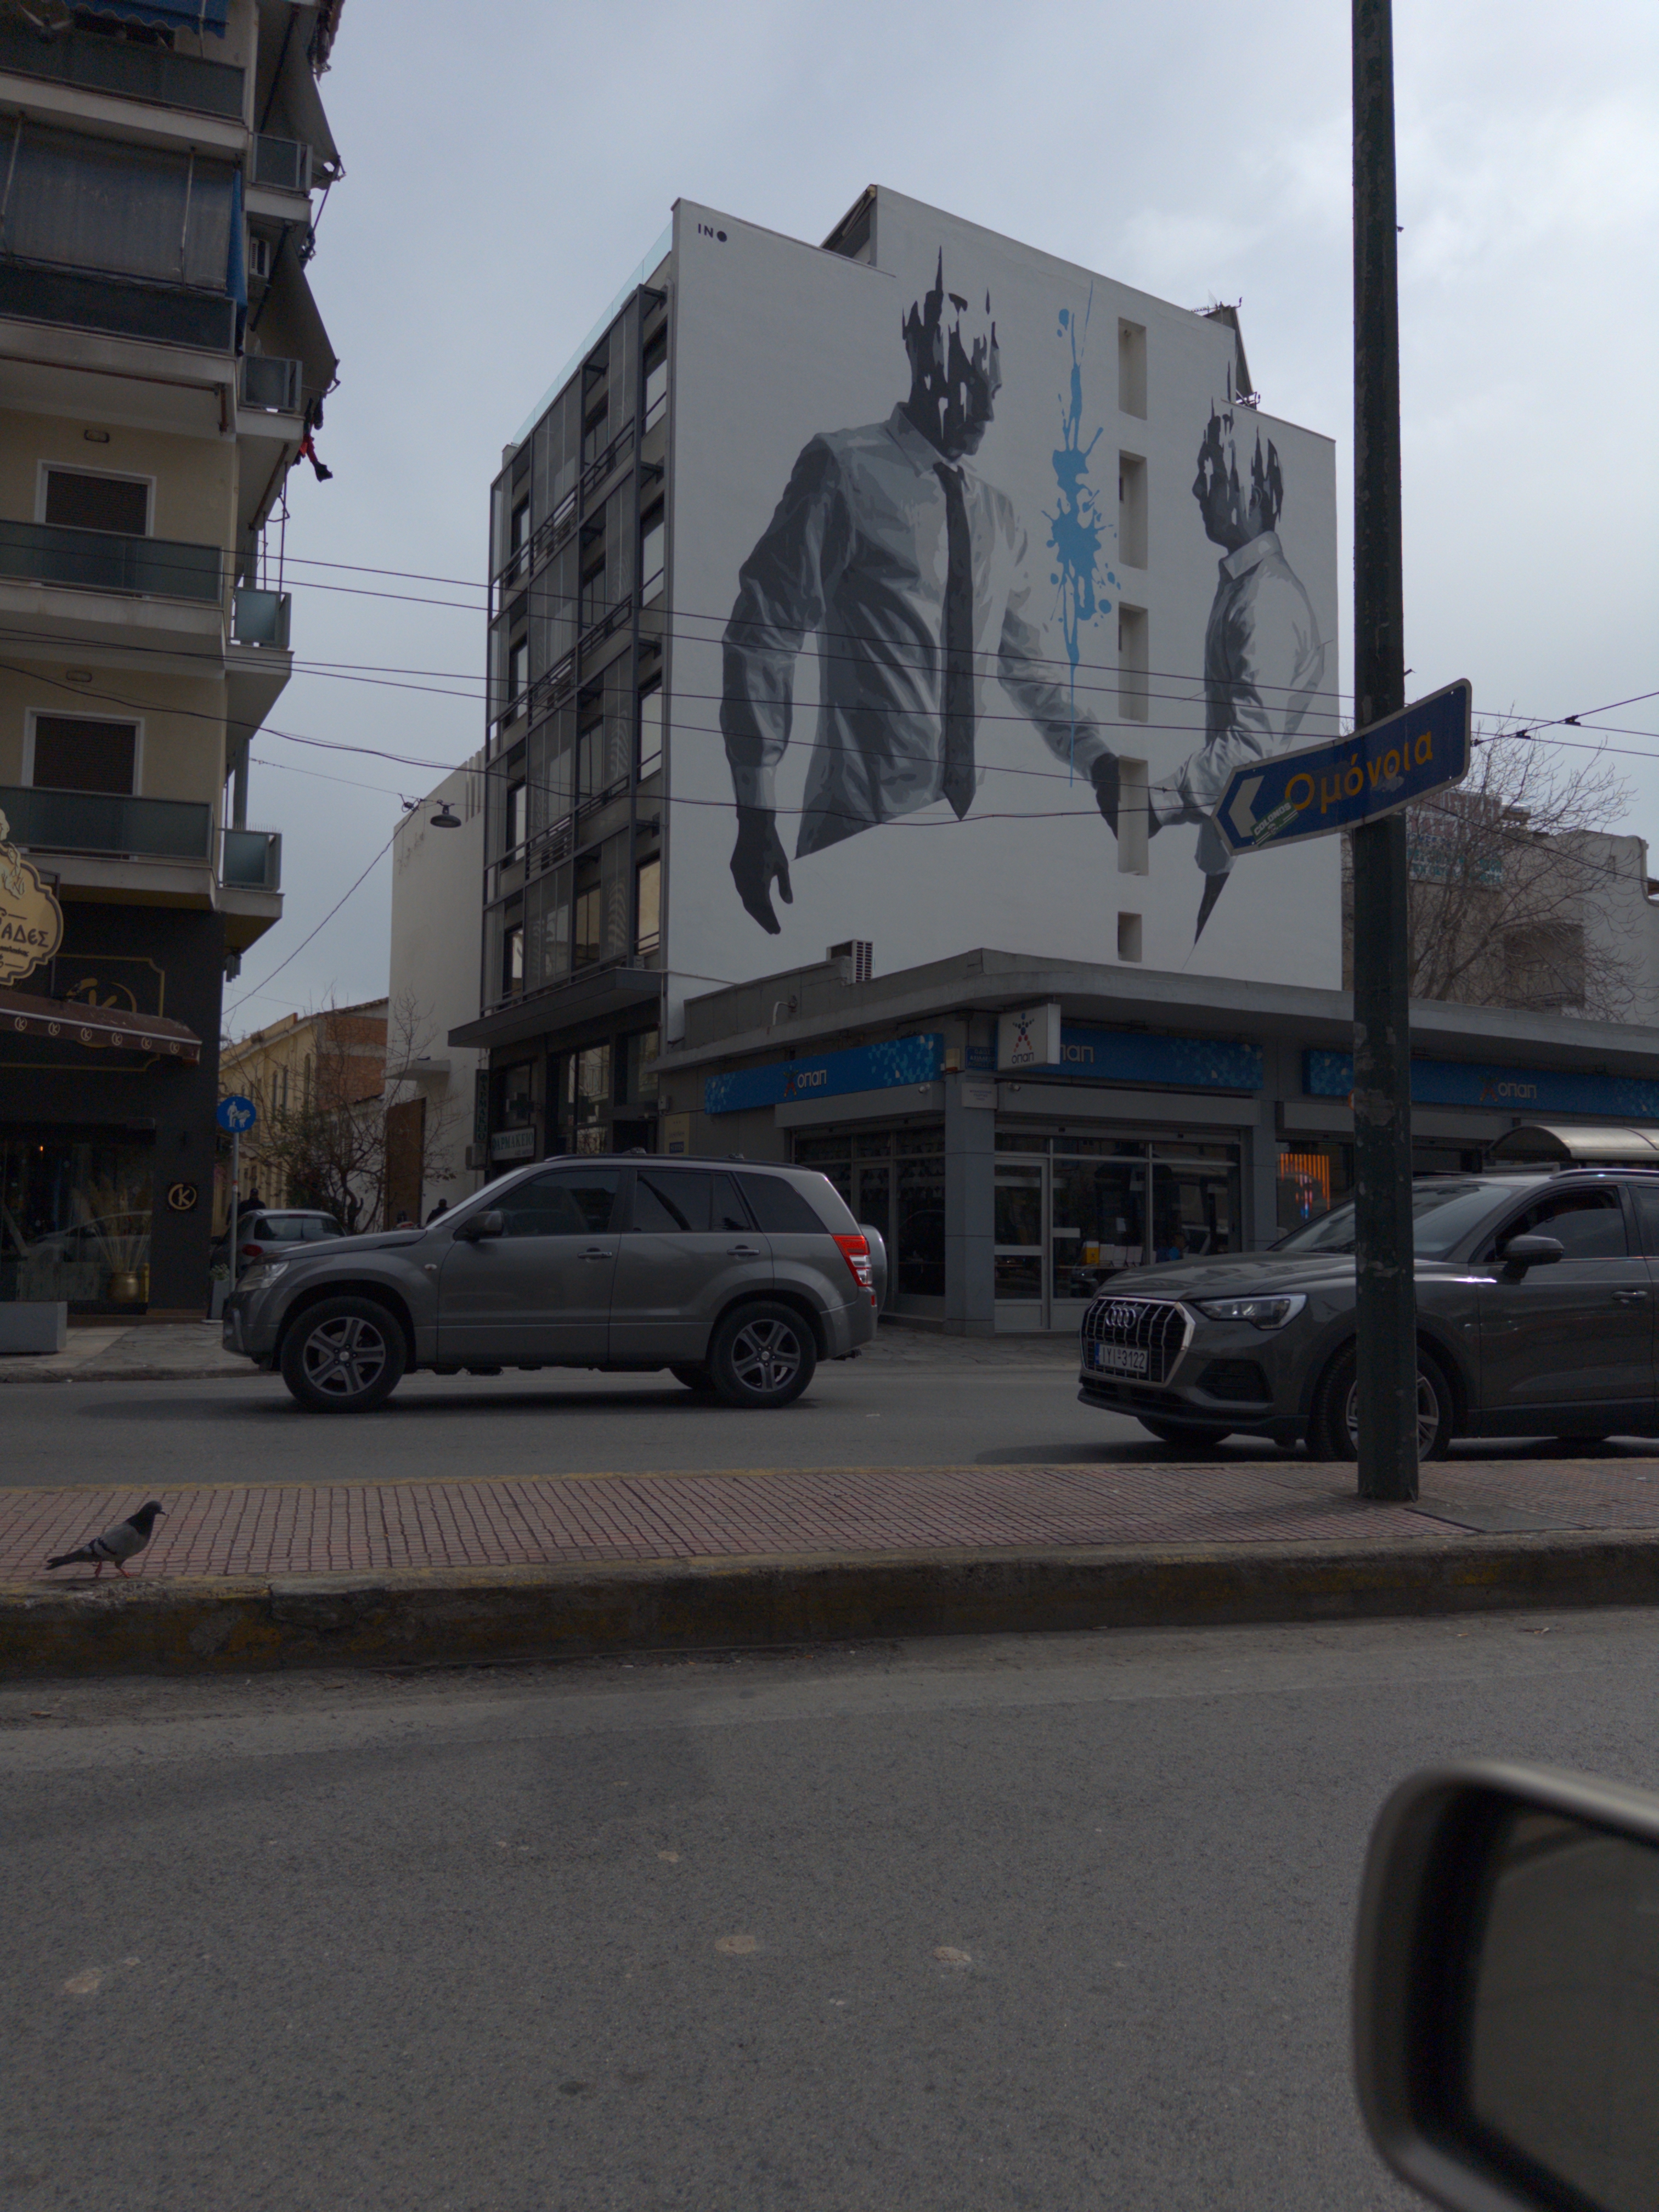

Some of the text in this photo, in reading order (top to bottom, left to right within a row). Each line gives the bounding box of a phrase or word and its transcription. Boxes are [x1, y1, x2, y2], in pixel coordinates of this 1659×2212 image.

[1285, 731, 1433, 814] Ομόνοια
[1254, 803, 1291, 836] COLONOS
[0, 917, 49, 948] ΑΔΕΣ
[492, 1132, 534, 1152] ΦΑΡΜΑΚΕΙΟ
